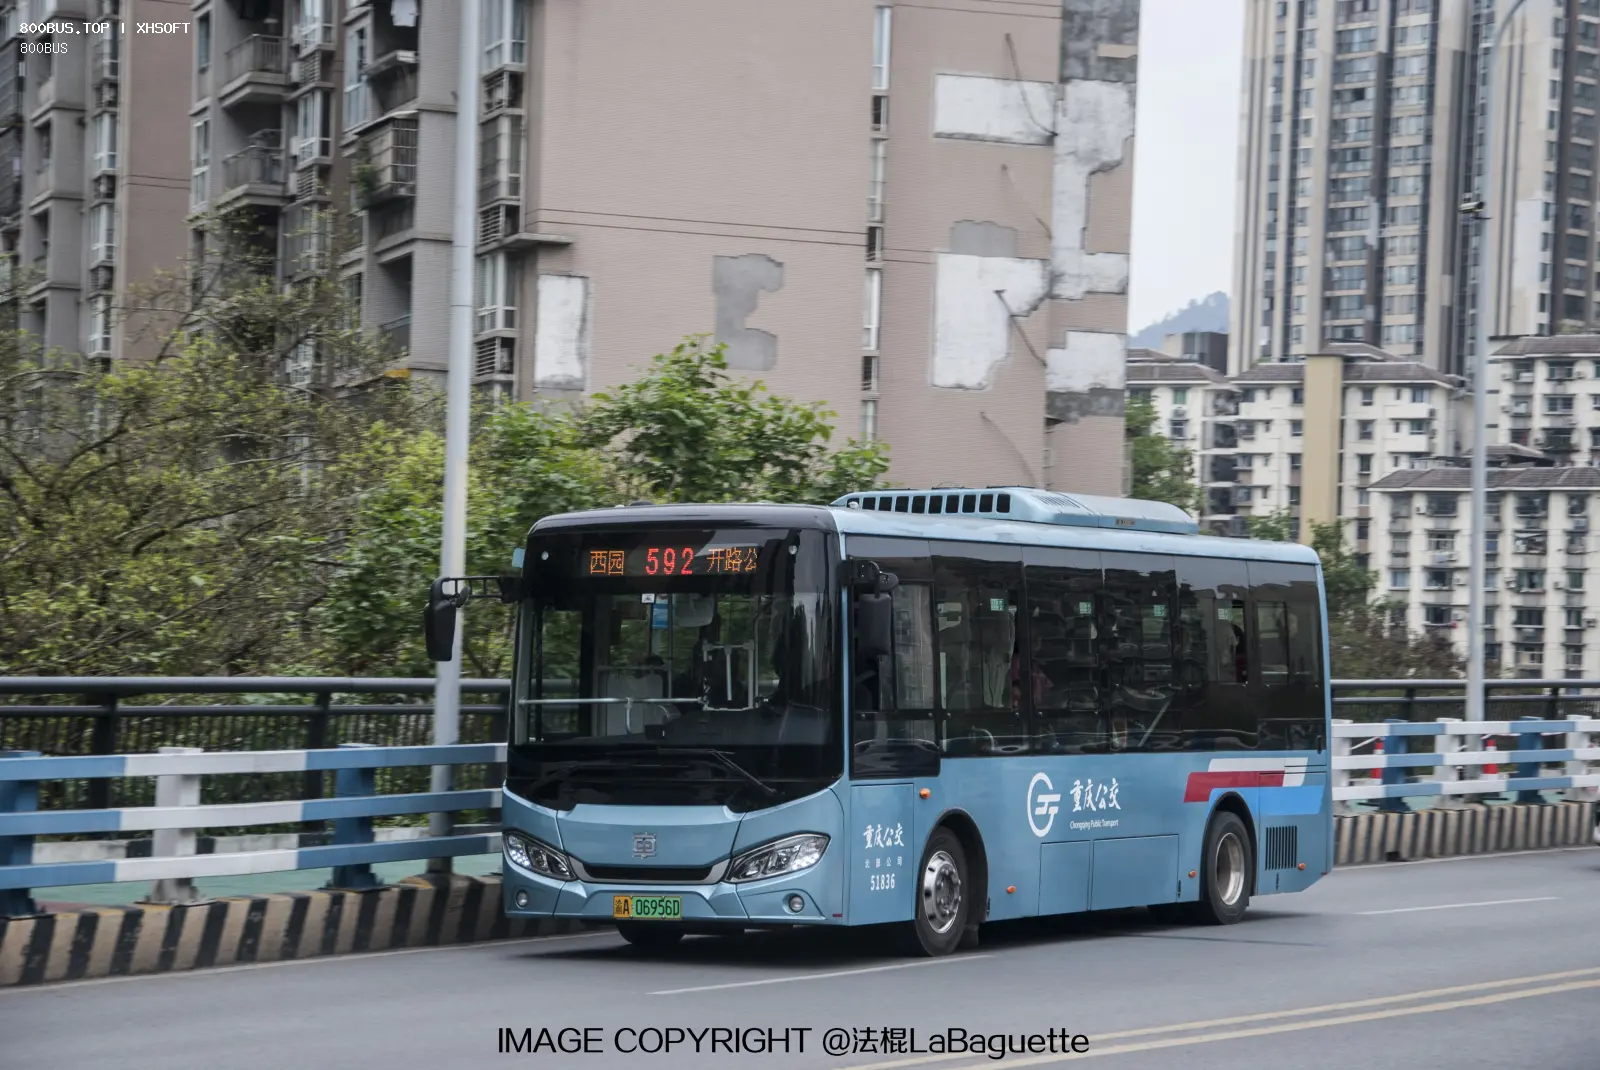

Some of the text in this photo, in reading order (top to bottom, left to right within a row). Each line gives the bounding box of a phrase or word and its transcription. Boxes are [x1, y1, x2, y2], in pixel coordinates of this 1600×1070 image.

[590, 550, 625, 575] 西园
[645, 547, 694, 575] 592
[1069, 777, 1122, 813] 重庆公交
[863, 822, 905, 849] 重庆公交
[1069, 818, 1119, 831] Chongqing Public Transport
[870, 873, 896, 891] 51836
[635, 899, 680, 916] 06956D
